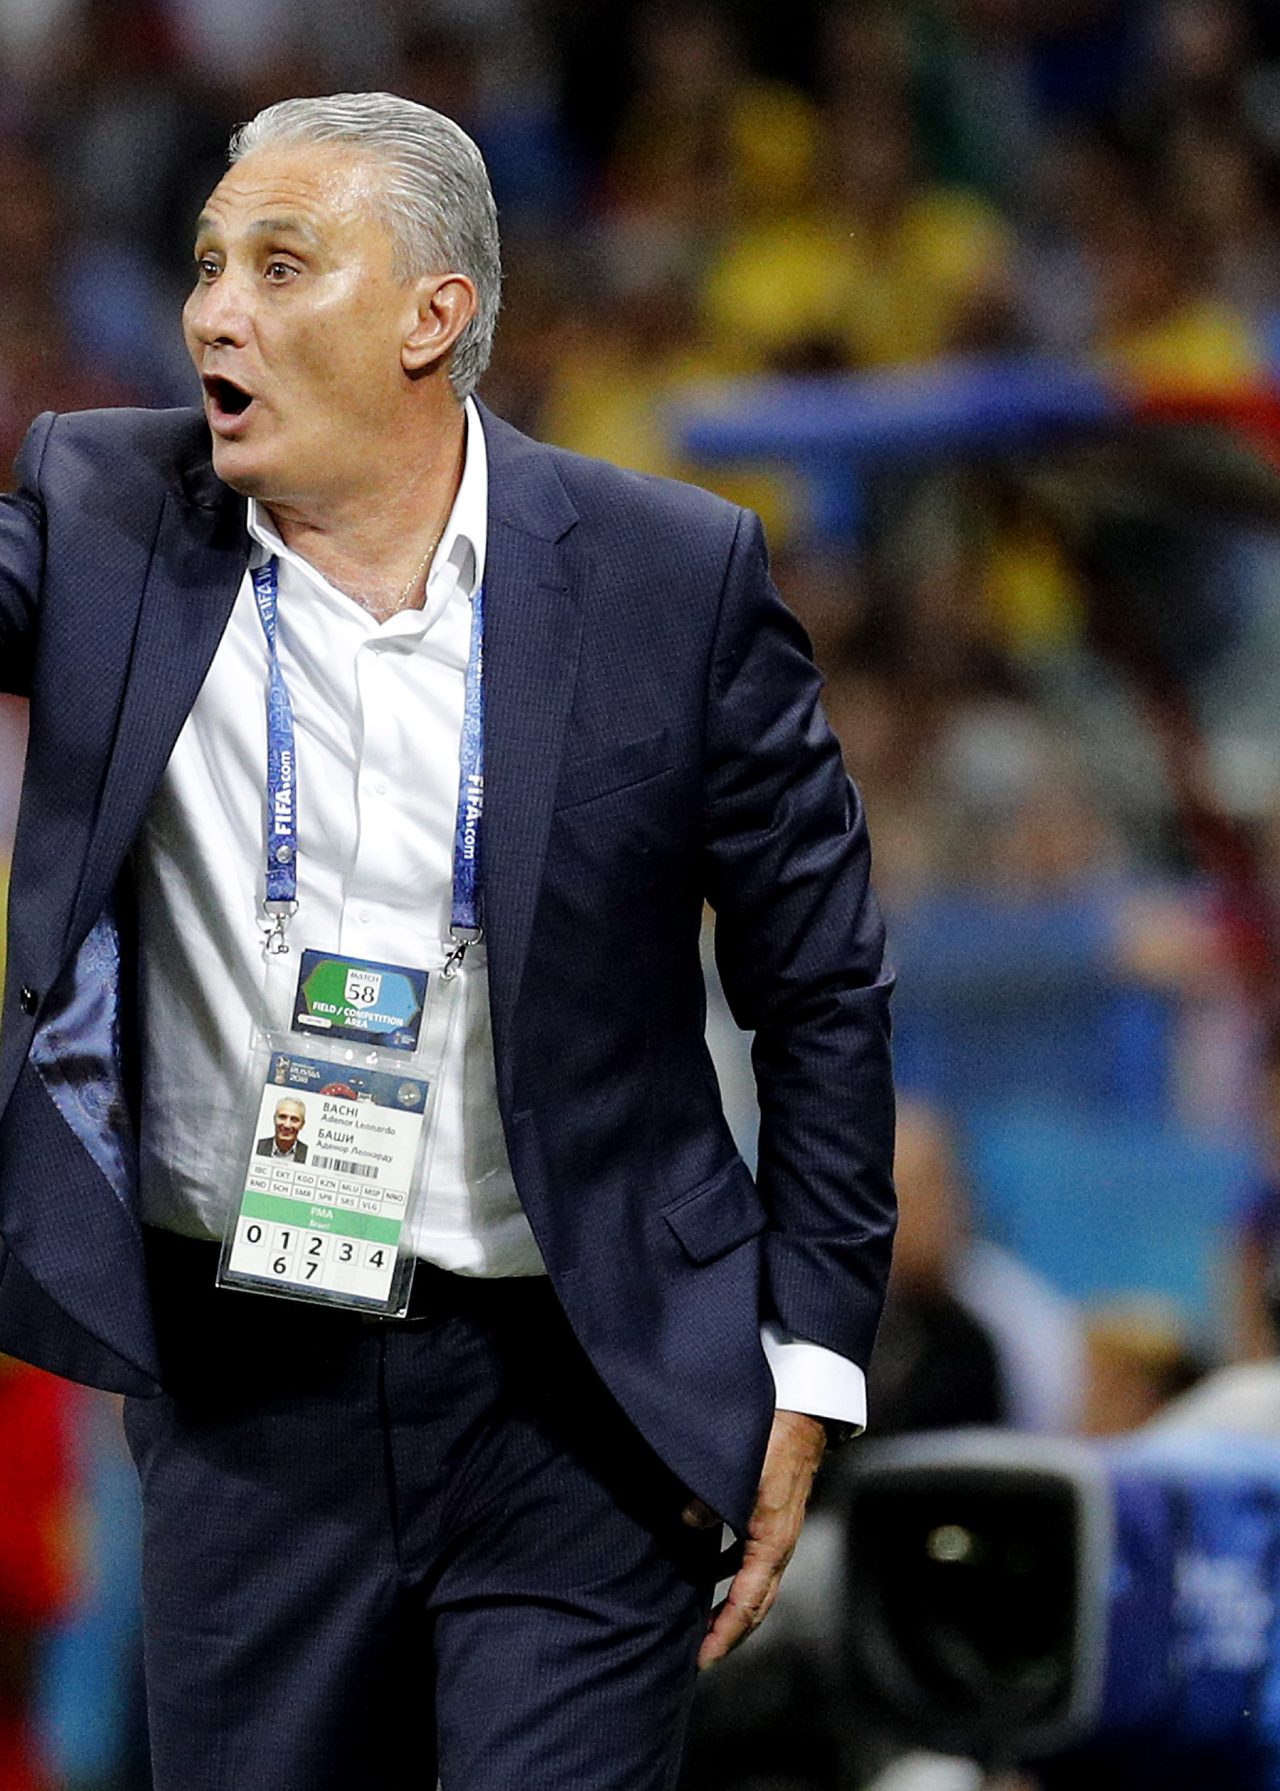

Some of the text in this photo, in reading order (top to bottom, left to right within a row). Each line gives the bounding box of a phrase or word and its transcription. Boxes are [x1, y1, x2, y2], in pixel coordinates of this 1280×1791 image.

[275, 750, 291, 834] FIFA.com
[463, 774, 484, 859] FIFA.com
[349, 971, 379, 982] MATCH
[346, 984, 375, 1004] 58
[312, 1001, 337, 1014] FIELD
[343, 1007, 404, 1027] COMPETITION
[344, 1017, 368, 1029] AREA
[322, 1102, 359, 1117] BACHI
[321, 1113, 353, 1127] Adenor
[317, 1128, 355, 1144] БАШИ
[246, 1224, 384, 1268] 0 1 2 3 4
[273, 1257, 319, 1280] 6 7
